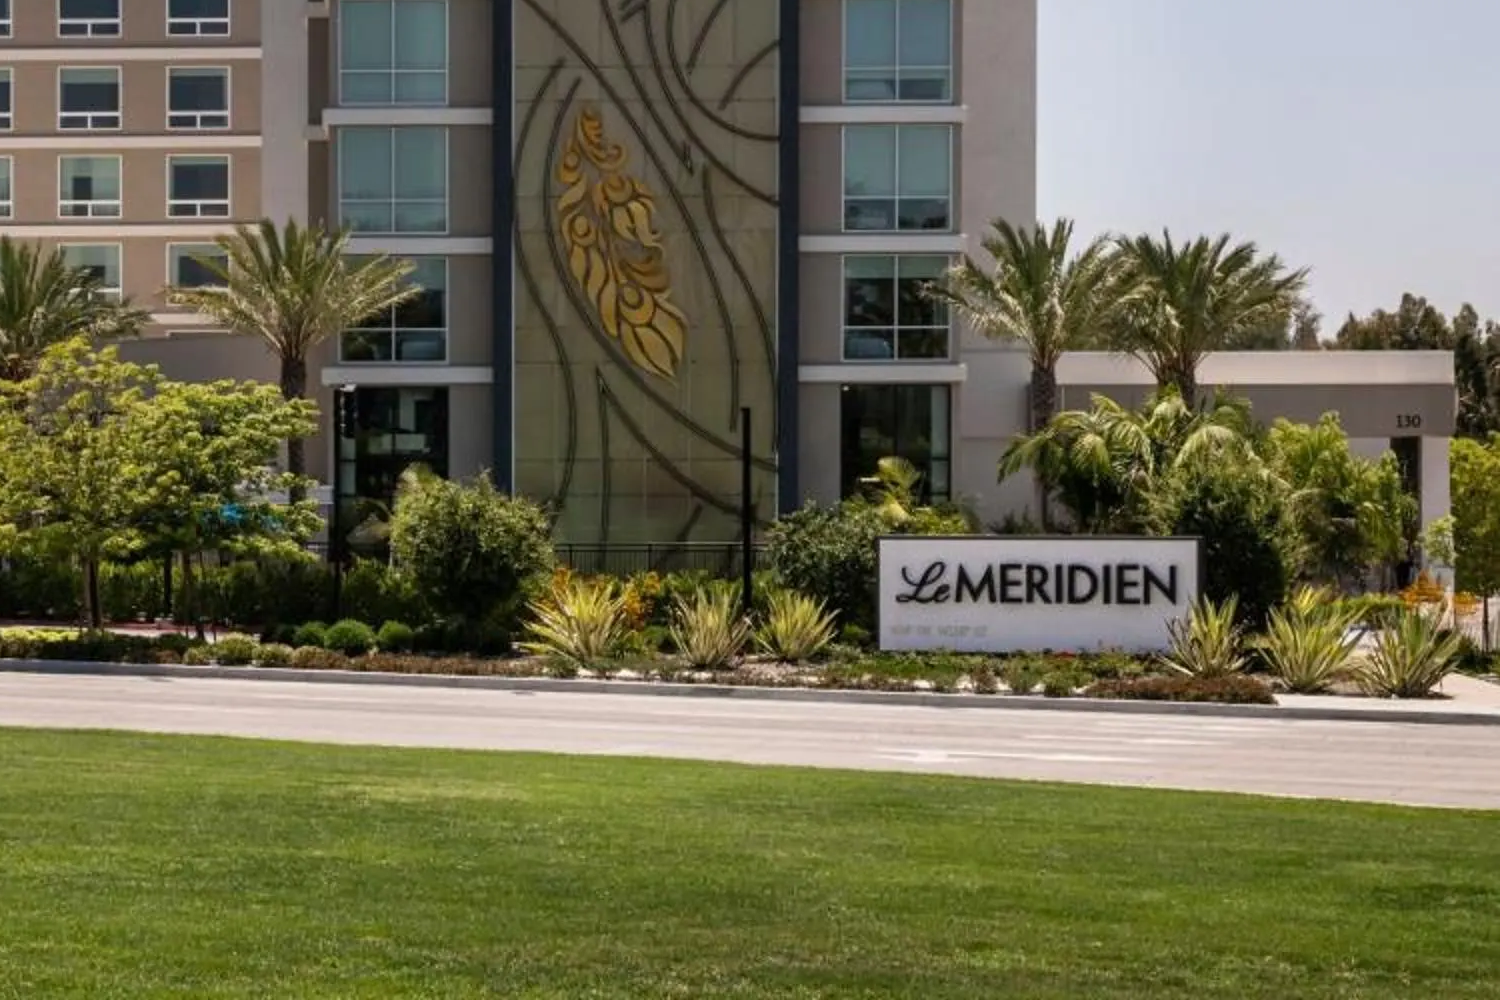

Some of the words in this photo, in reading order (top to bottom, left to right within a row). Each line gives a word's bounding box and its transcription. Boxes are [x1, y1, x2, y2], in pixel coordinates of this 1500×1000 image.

[1396, 414, 1421, 428] 130
[896, 562, 950, 603] Le
[955, 563, 1178, 605] MERIDIEN
